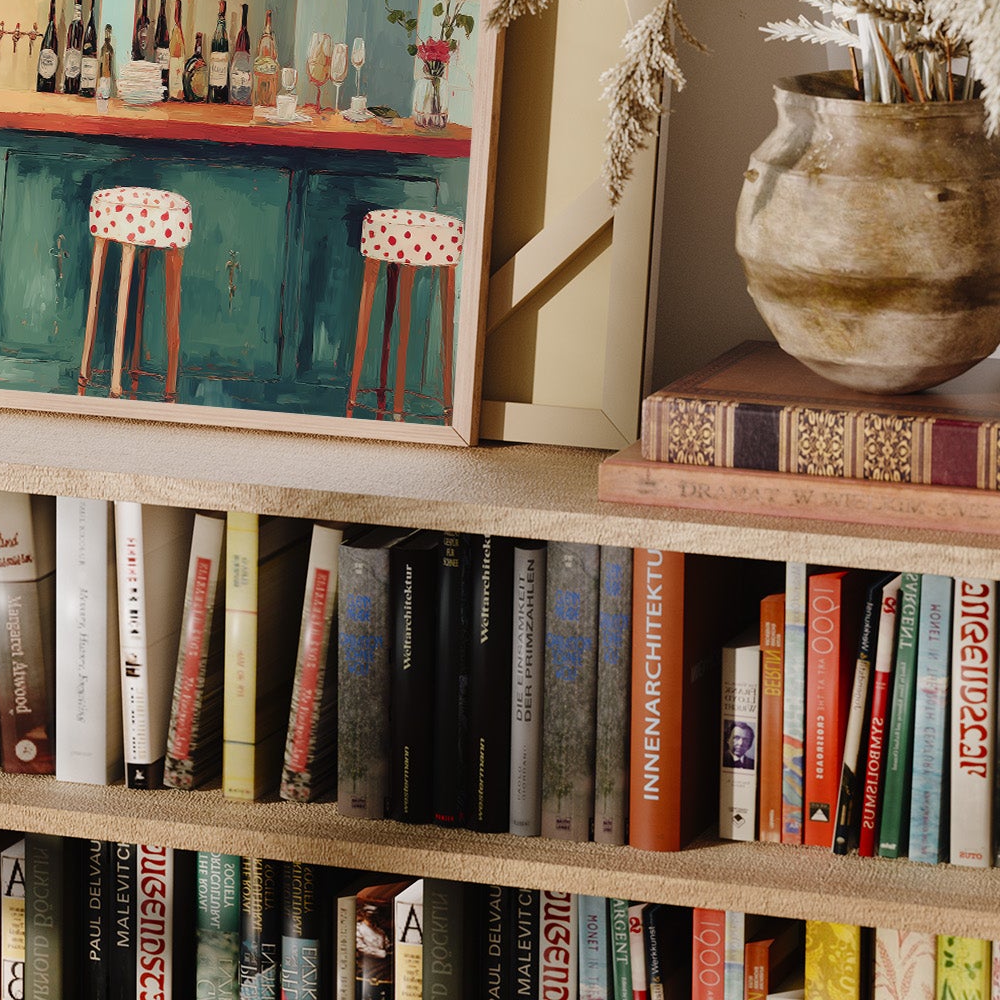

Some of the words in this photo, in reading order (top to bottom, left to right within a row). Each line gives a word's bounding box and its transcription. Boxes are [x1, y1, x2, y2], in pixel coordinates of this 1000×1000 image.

[6, 595, 25, 658] Margaret
[403, 564, 413, 670] Weltarchitektur
[524, 559, 535, 679] PRIMZAHLEN
[11, 660, 32, 714] Atwood
[516, 692, 524, 722] DIE
[523, 685, 533, 722] DER
[643, 549, 663, 801] INNENARCHITEKTU
[402, 746, 411, 813] westermann
[477, 738, 487, 821] westermann
[89, 840, 102, 911] DELVAU
[90, 916, 102, 961] PAUL
[488, 886, 501, 957] DELVAU
[587, 914, 599, 952] MONET
[613, 899, 630, 966] ARGENT
[647, 926, 660, 975] Werkkunst
[695, 921, 721, 987] 1900
